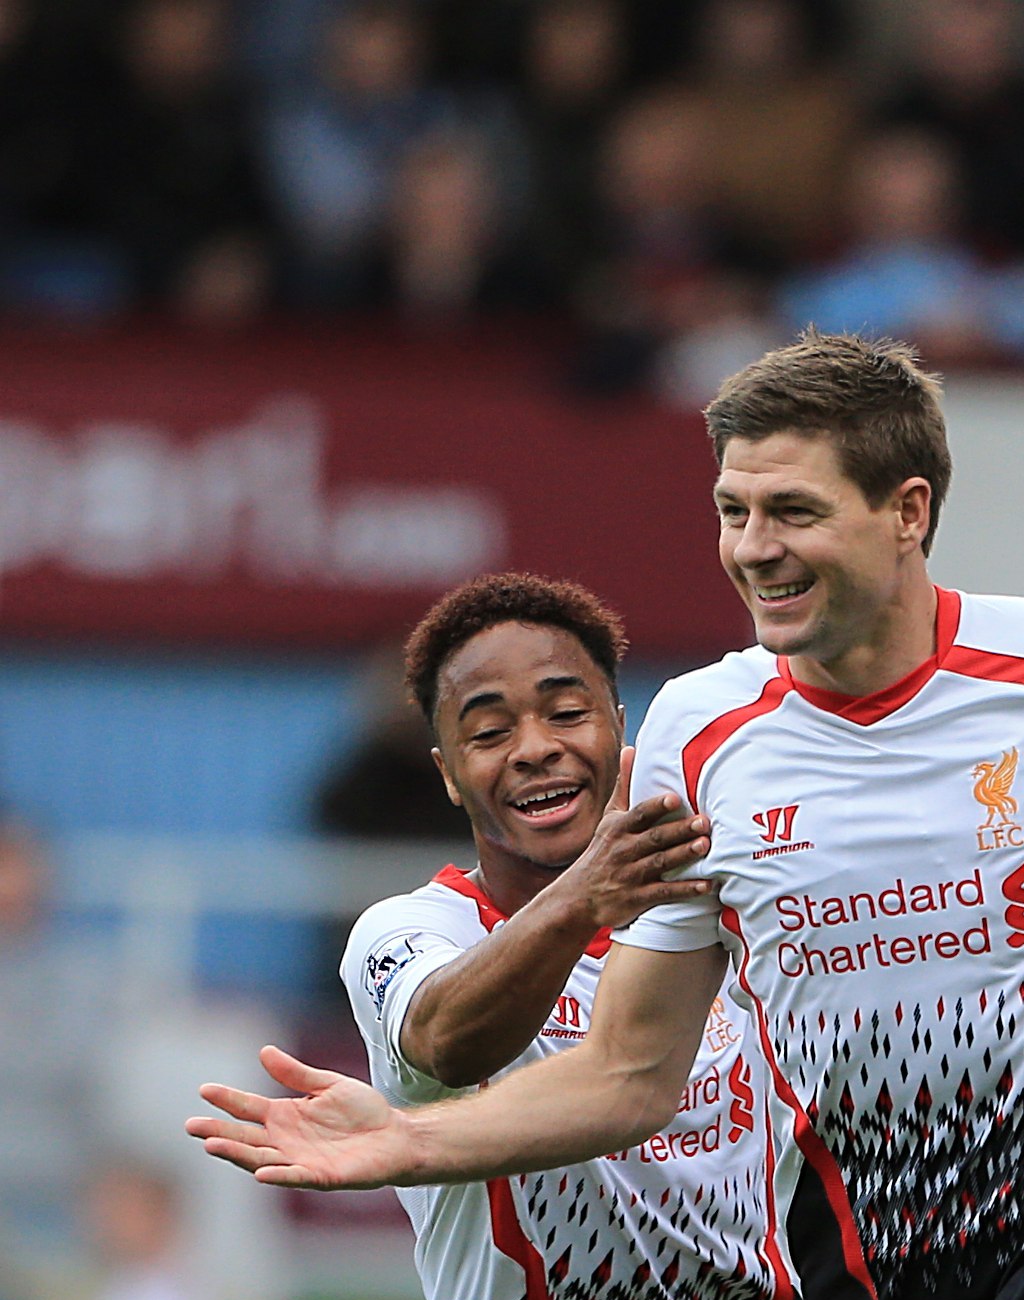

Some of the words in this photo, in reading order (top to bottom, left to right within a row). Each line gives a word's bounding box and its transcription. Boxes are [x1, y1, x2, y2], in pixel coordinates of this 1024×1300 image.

[752, 841, 810, 860] WARRIOR
[776, 868, 985, 932] Standard
[778, 917, 991, 977] Chartered
